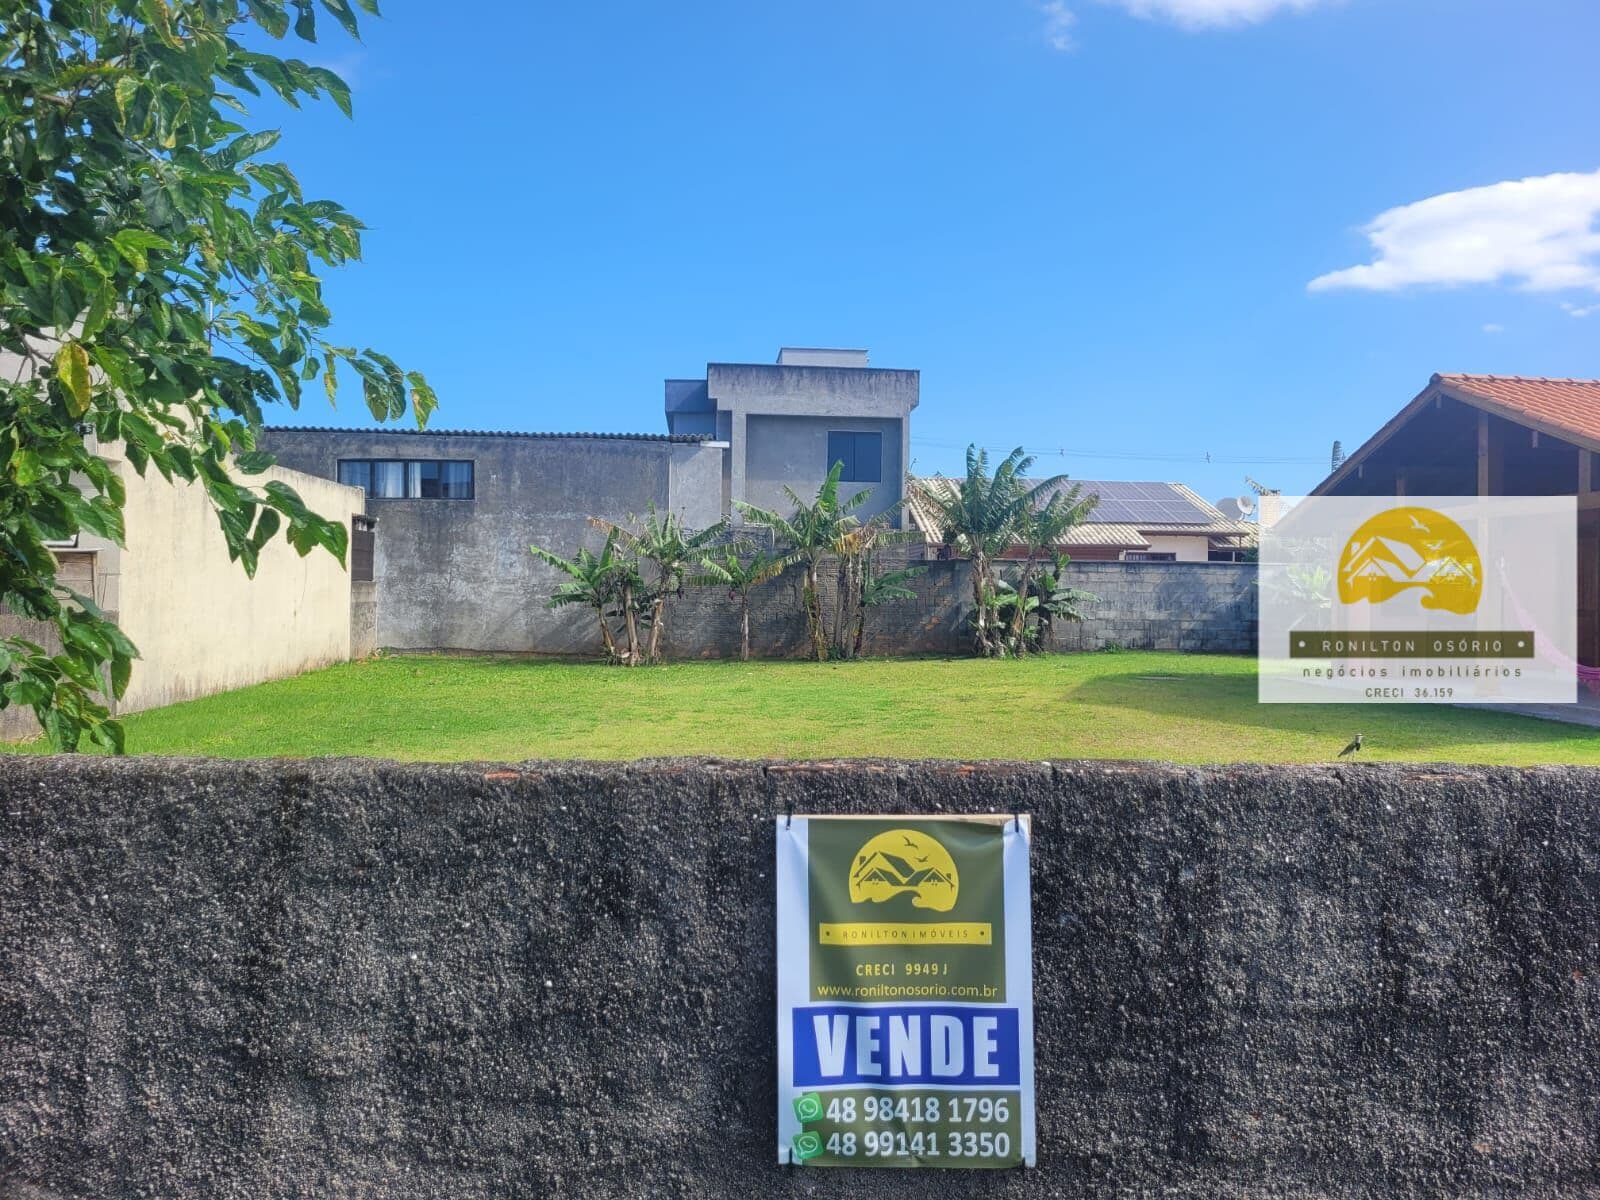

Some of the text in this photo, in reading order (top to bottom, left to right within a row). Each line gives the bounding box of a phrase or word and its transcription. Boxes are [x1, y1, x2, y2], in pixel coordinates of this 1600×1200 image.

[856, 963, 947, 976] CRECI 9949 J
[818, 983, 998, 997] www.roniltonosorio.com.br
[813, 1014, 999, 1077] VENDE
[826, 1096, 1009, 1123] 48 98418 1796
[826, 1131, 1009, 1157] 48 99141 3350
